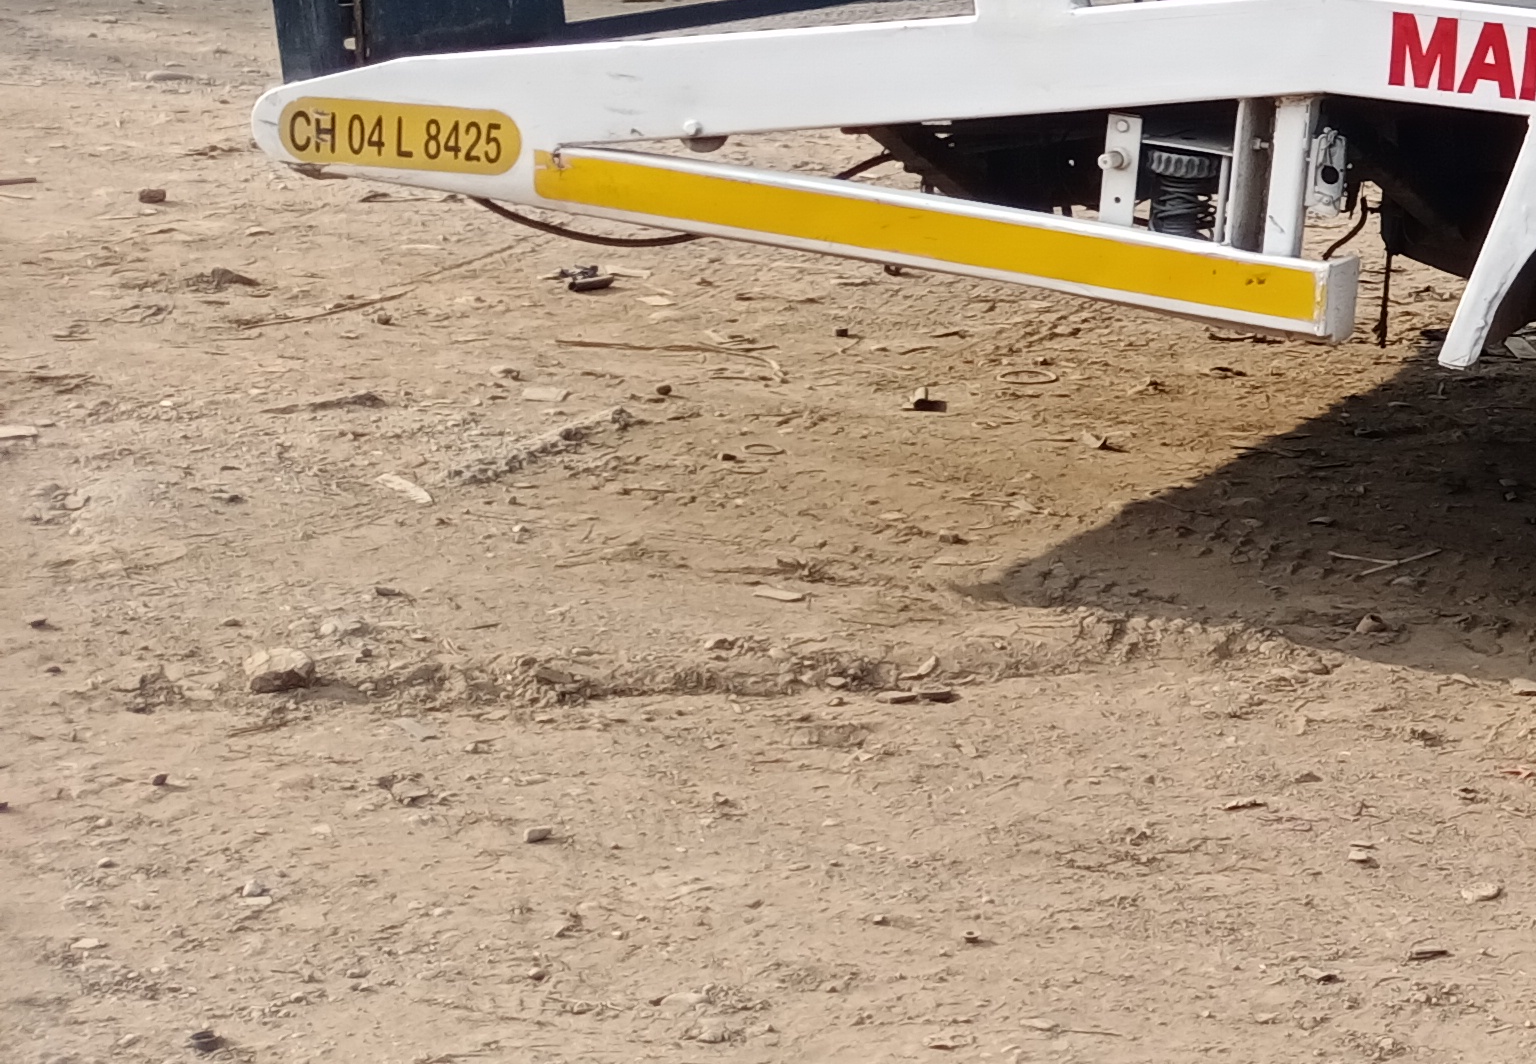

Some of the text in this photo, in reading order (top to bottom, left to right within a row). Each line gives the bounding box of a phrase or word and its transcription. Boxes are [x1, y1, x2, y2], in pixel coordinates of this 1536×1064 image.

[289, 109, 503, 164] CH 04 L 8425
